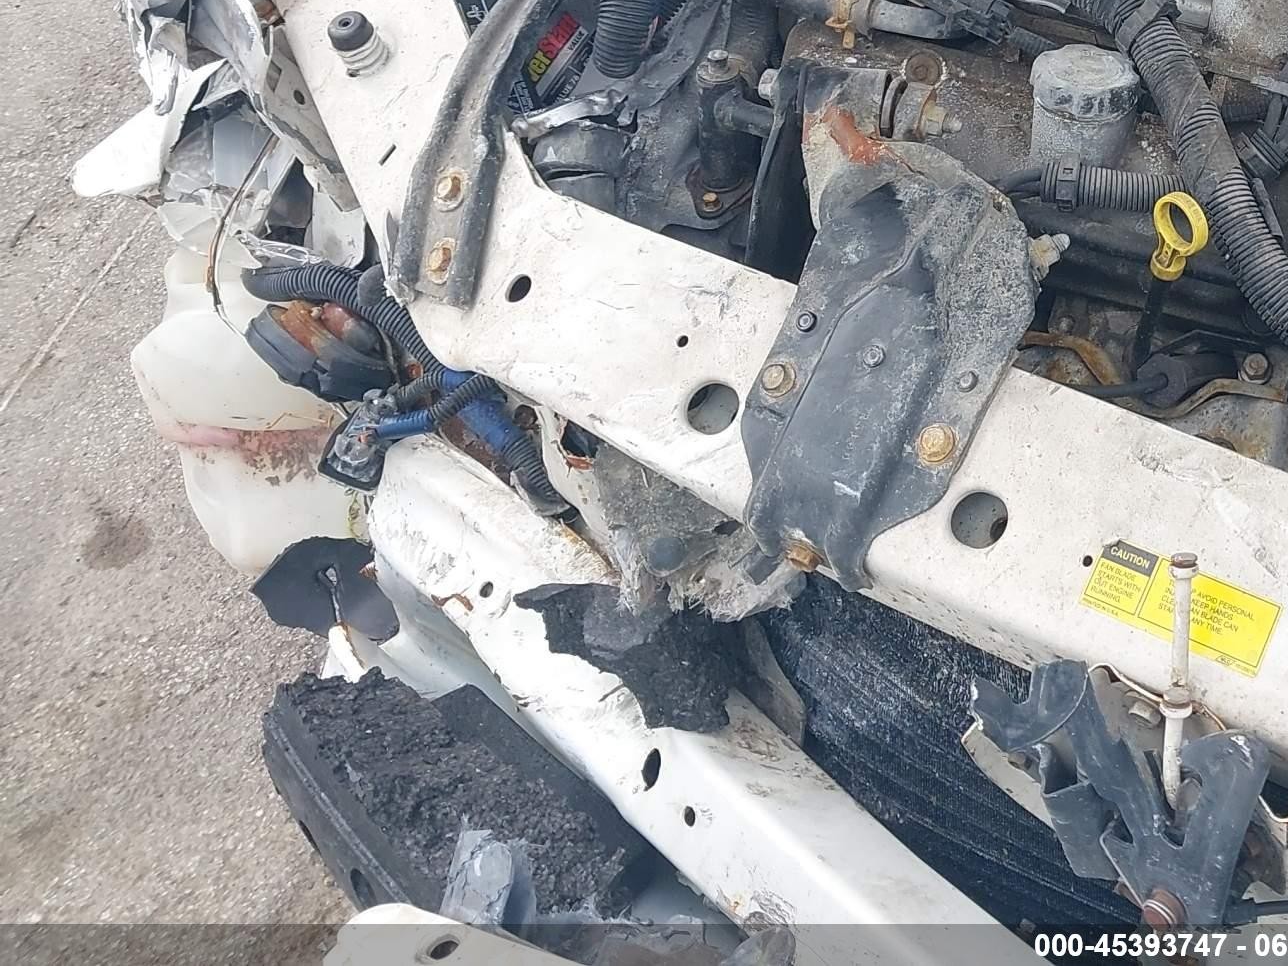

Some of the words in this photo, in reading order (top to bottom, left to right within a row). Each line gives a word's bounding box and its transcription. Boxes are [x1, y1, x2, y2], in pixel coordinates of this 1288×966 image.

[1111, 545, 1150, 570] CAUTION
[1097, 570, 1123, 587] STARTS
[1100, 562, 1114, 573] FAN
[1114, 568, 1136, 583] BLADE
[1093, 578, 1107, 589] OUT
[1108, 584, 1134, 601] ENGINE
[1191, 599, 1209, 611] KEEP
[1209, 606, 1233, 621] HANDS
[1196, 591, 1218, 605] AVOID
[1218, 600, 1256, 622] PERSONAL
[1190, 617, 1203, 627] ANY
[1200, 612, 1223, 626] BLADE
[1222, 621, 1238, 633] CAN
